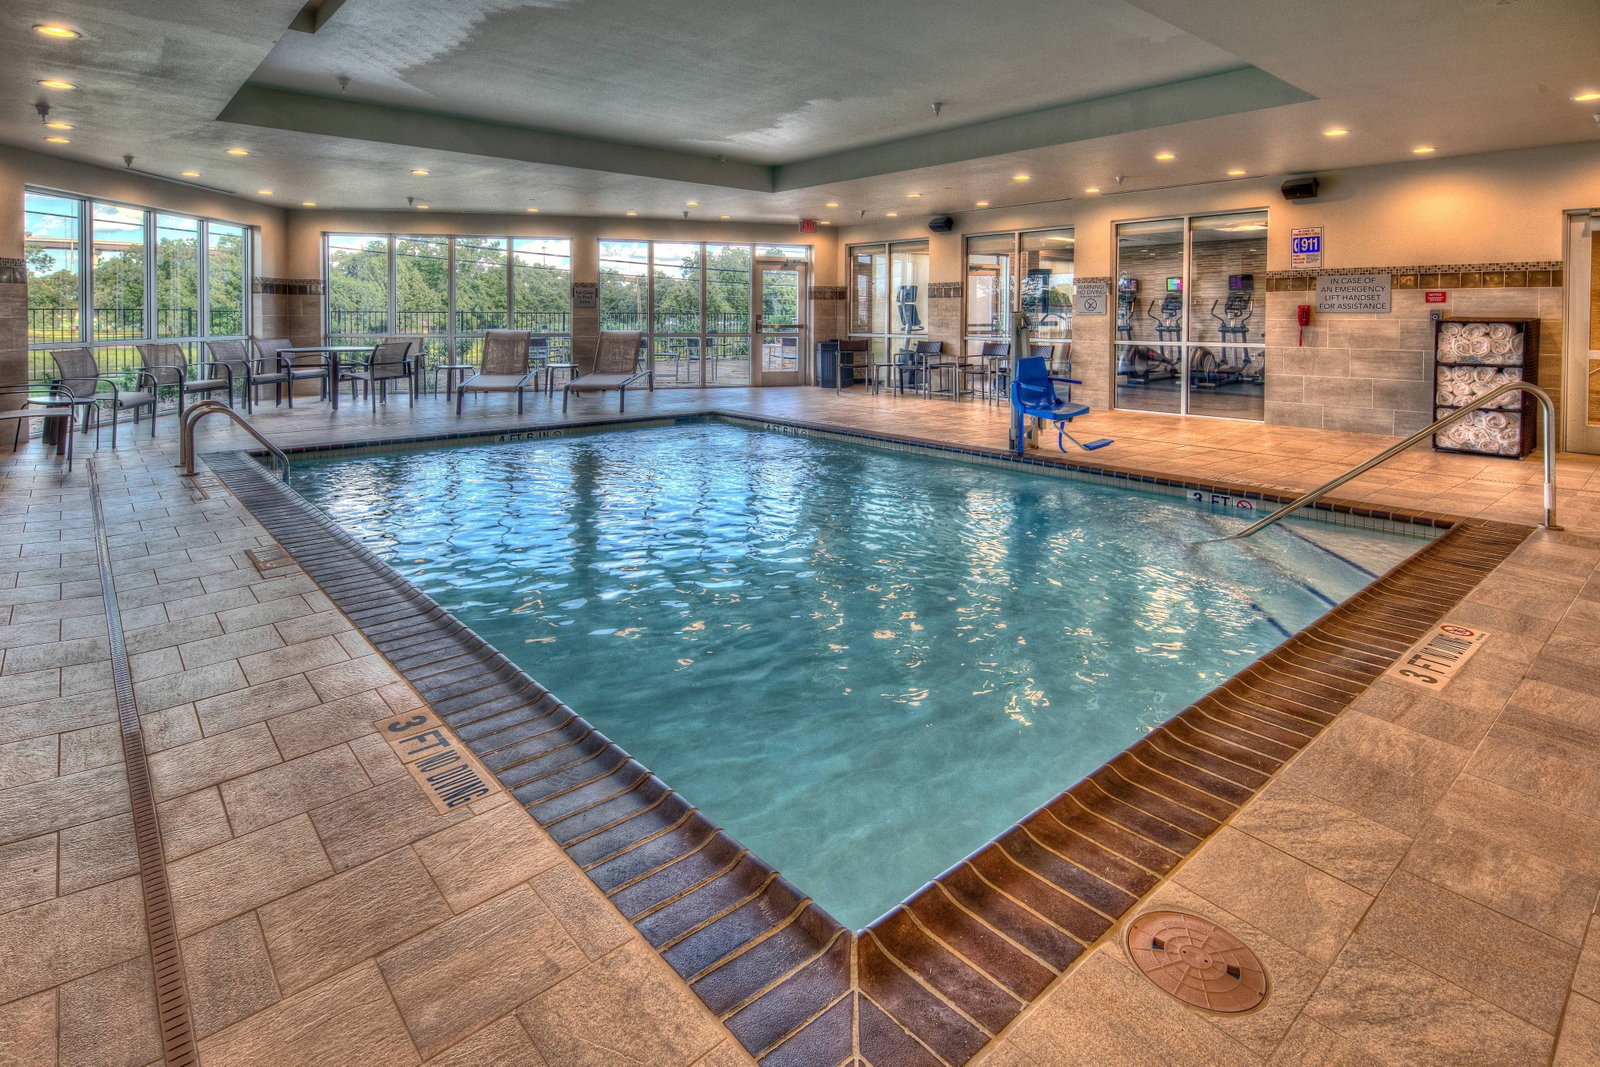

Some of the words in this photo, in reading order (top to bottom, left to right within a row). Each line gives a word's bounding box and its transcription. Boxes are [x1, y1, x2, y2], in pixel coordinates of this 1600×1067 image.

[1301, 237, 1318, 251] 911
[1364, 276, 1376, 284] OF
[1337, 302, 1387, 310] ASSISTANCE
[1211, 494, 1231, 506] FT
[1407, 653, 1452, 675] FT
[1398, 668, 1438, 684] 3
[387, 714, 428, 732] 3
[398, 729, 451, 755] FT
[414, 749, 462, 773] NO
[426, 763, 490, 808] DIVING
